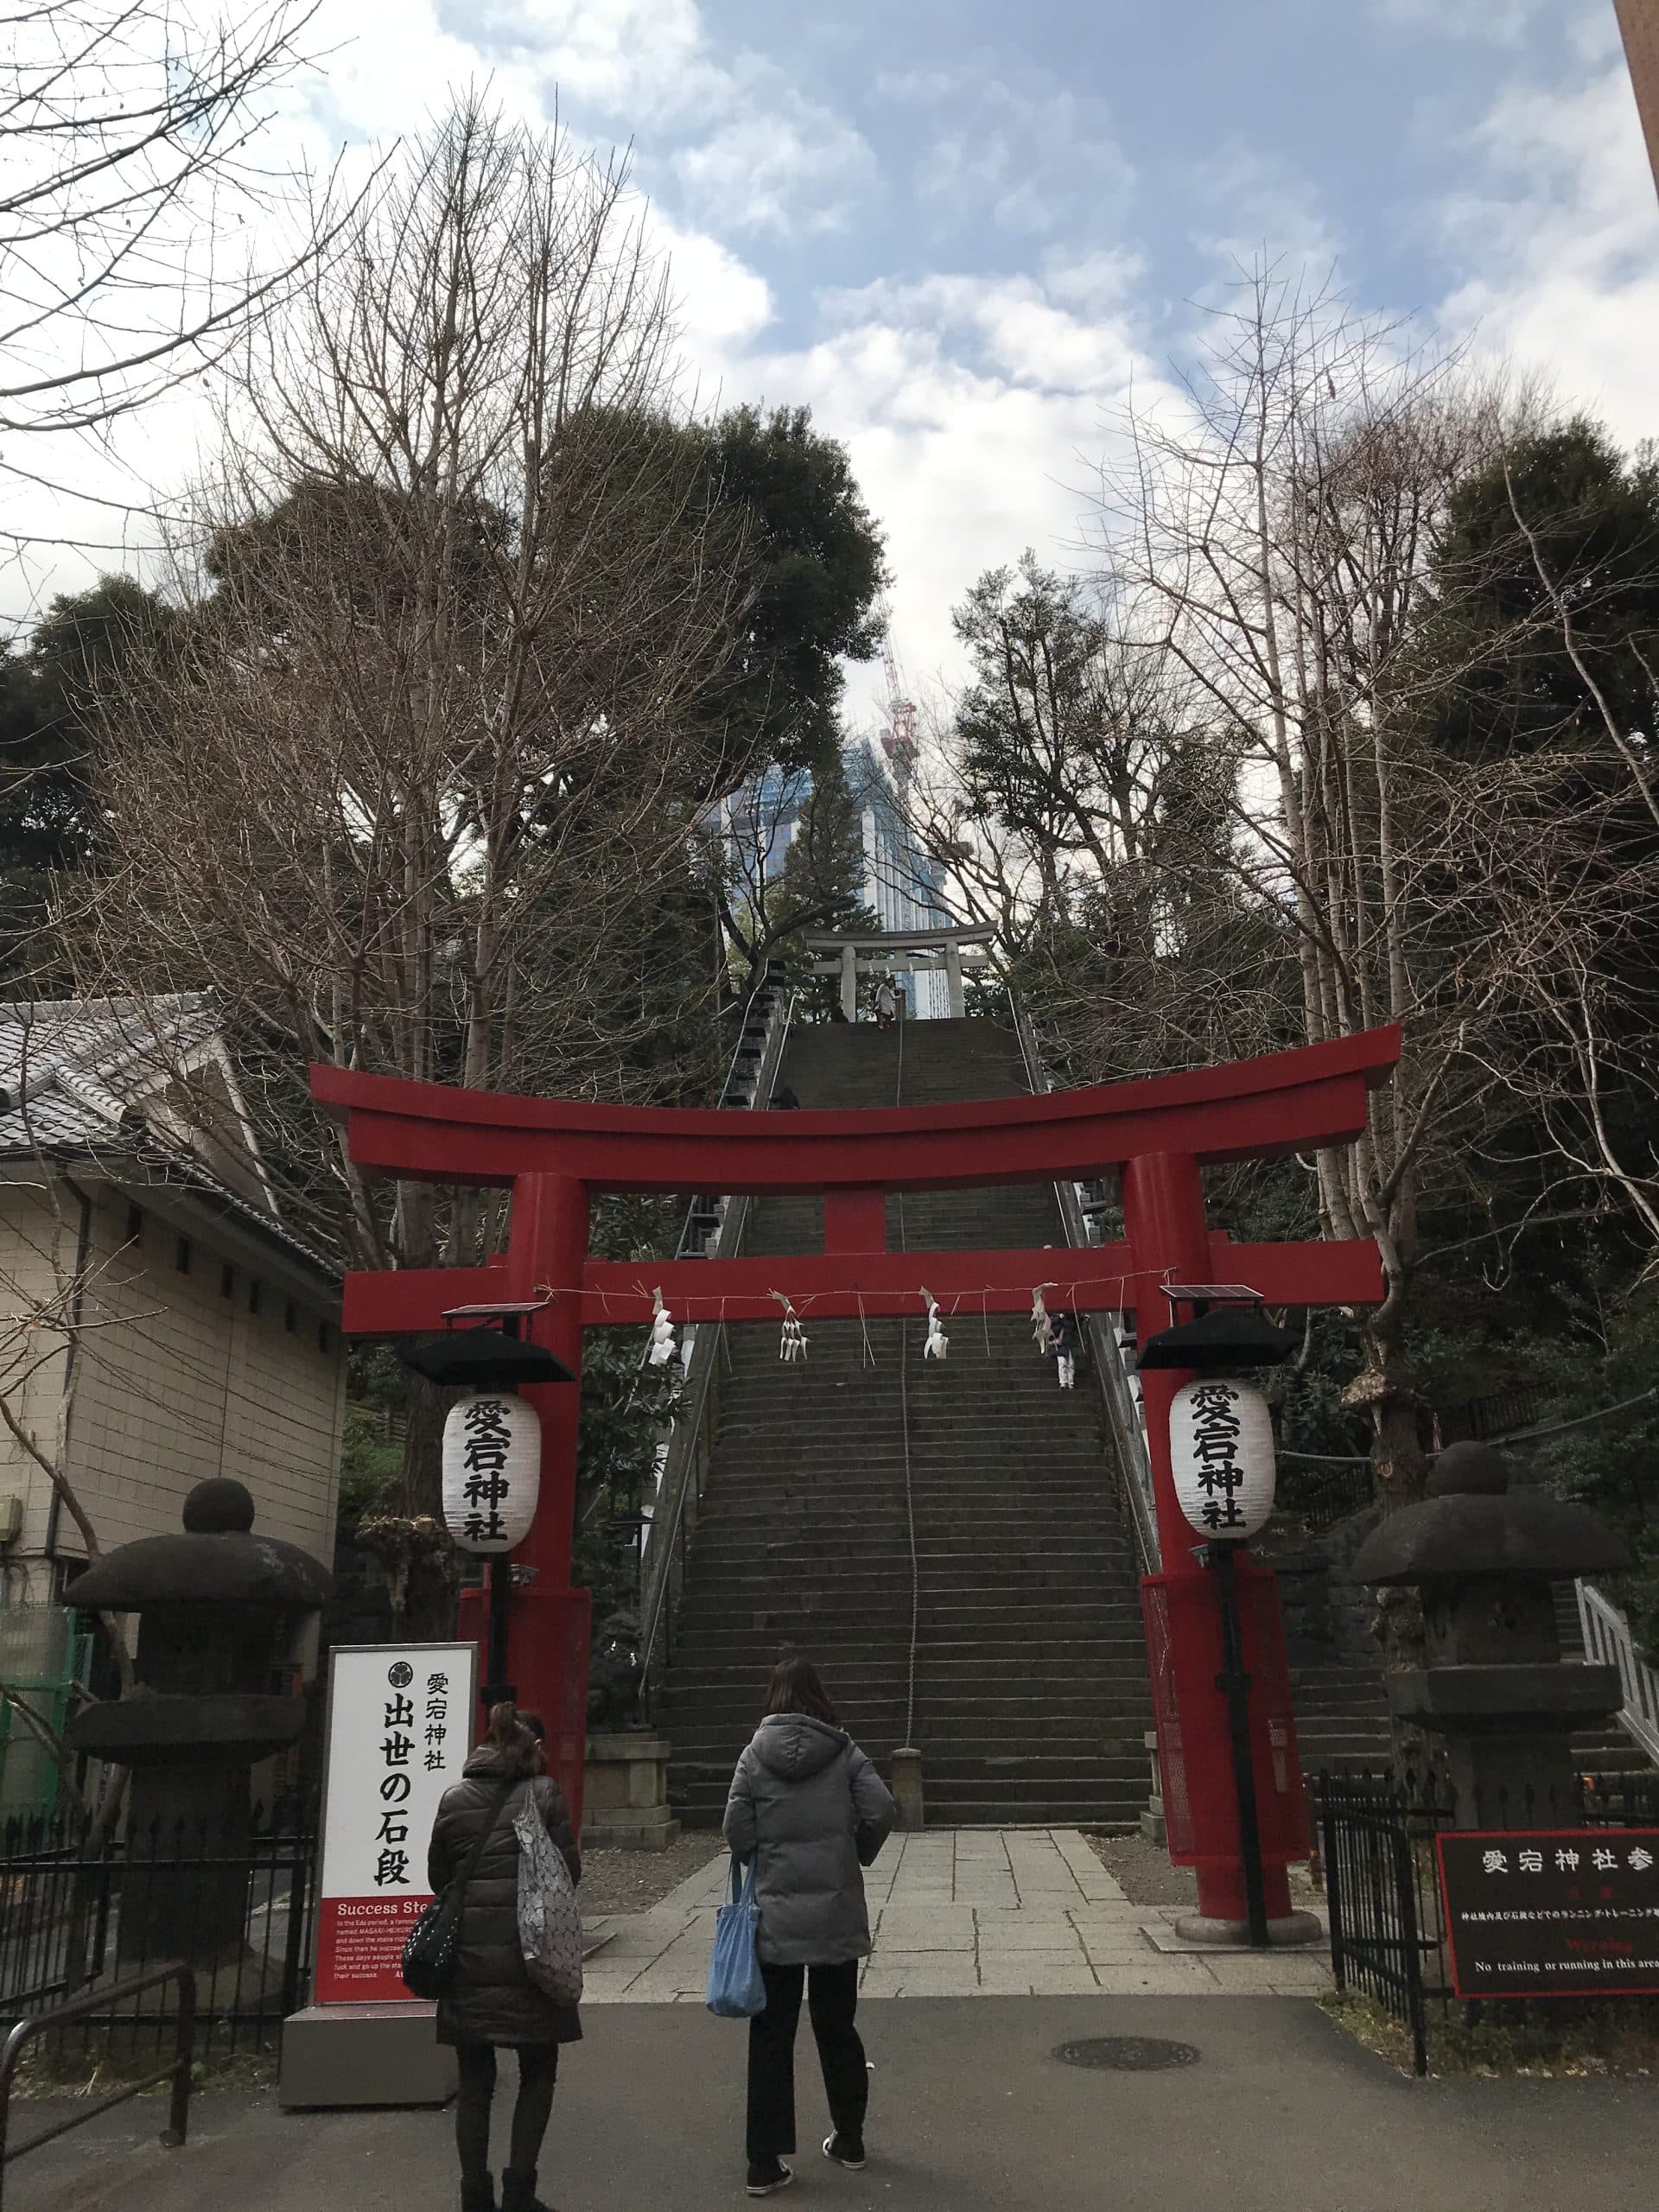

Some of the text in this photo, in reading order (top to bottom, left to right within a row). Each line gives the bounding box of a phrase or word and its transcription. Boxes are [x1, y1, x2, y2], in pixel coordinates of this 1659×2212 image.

[463, 1400, 512, 1542] 愛宕神社
[1190, 1384, 1247, 1531] 愛宕神社
[423, 1672, 448, 1771] 愛宕神社
[373, 1693, 416, 1887] 出世の石段
[338, 1901, 428, 1916] Success Ste
[1482, 1847, 1654, 1873] 愛宕神社参
[1474, 1961, 1492, 1972] No
[1497, 1961, 1540, 1974] training
[1544, 1962, 1556, 1971] or
[1559, 1959, 1600, 1972] running
[1602, 1958, 1614, 1969] in
[1616, 1957, 1636, 1969] this
